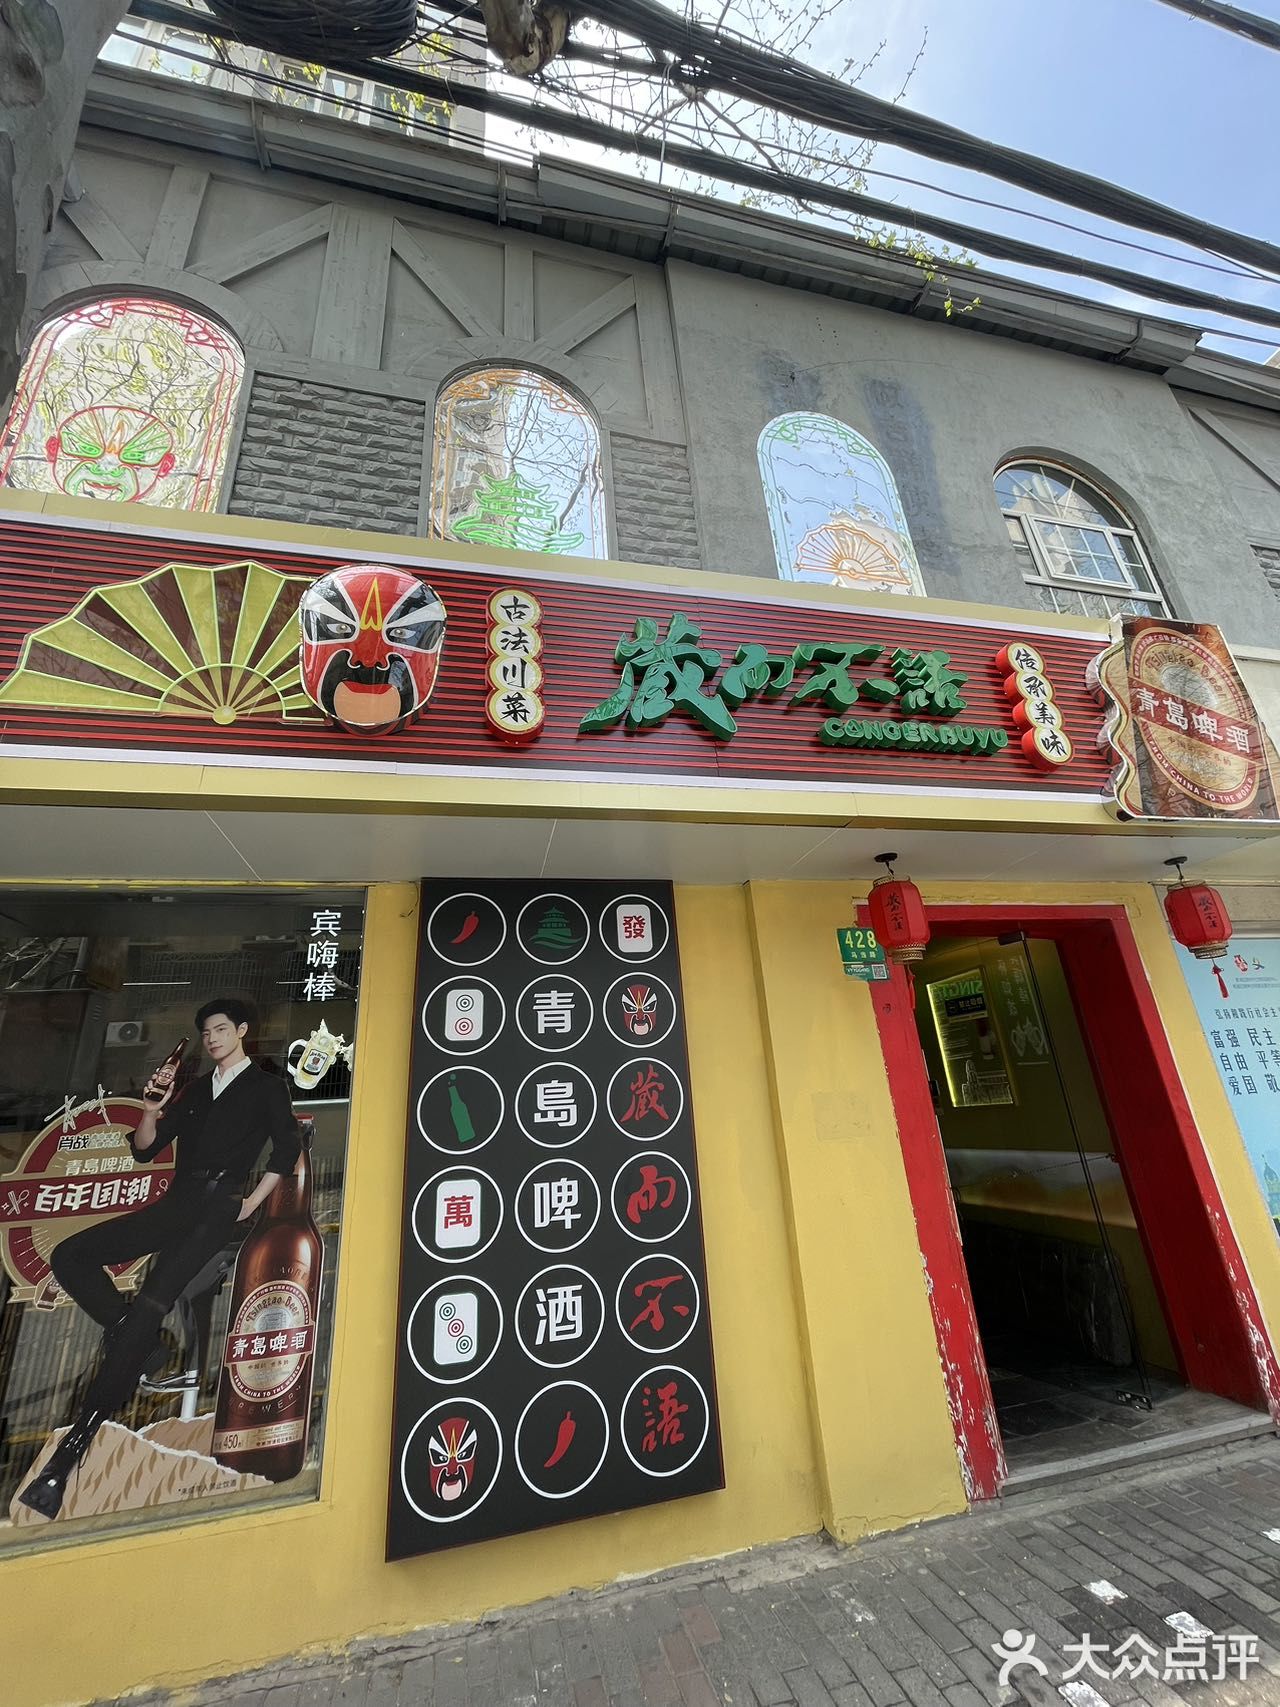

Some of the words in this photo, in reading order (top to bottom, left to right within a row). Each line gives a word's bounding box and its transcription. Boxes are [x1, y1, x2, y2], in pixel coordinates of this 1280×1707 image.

[500, 595, 531, 724] 古法川菜
[1015, 648, 1067, 756] 传承美味
[1170, 769, 1200, 795] CHINA
[1203, 792, 1216, 802] TO
[1219, 794, 1236, 804] THE
[622, 915, 646, 939] 發
[845, 930, 877, 949] 428
[303, 909, 341, 1002] 宾嗨棒
[1210, 1028, 1240, 1049] 富强
[1247, 1027, 1277, 1047] 民主
[1219, 1052, 1249, 1072] 自由
[1228, 1075, 1258, 1096] 爱国
[532, 990, 583, 1346] 青島啤酒
[34, 1174, 152, 1212] 百年国潮
[443, 1195, 474, 1229] 萬
[245, 1295, 283, 1323] Tsingtao
[285, 1295, 300, 1316] Beer
[233, 1375, 244, 1391] FROM
[243, 1388, 261, 1399] CHINA
[273, 1385, 284, 1395] THE
[284, 1365, 301, 1387] WORLD
[223, 1434, 239, 1449] 450
